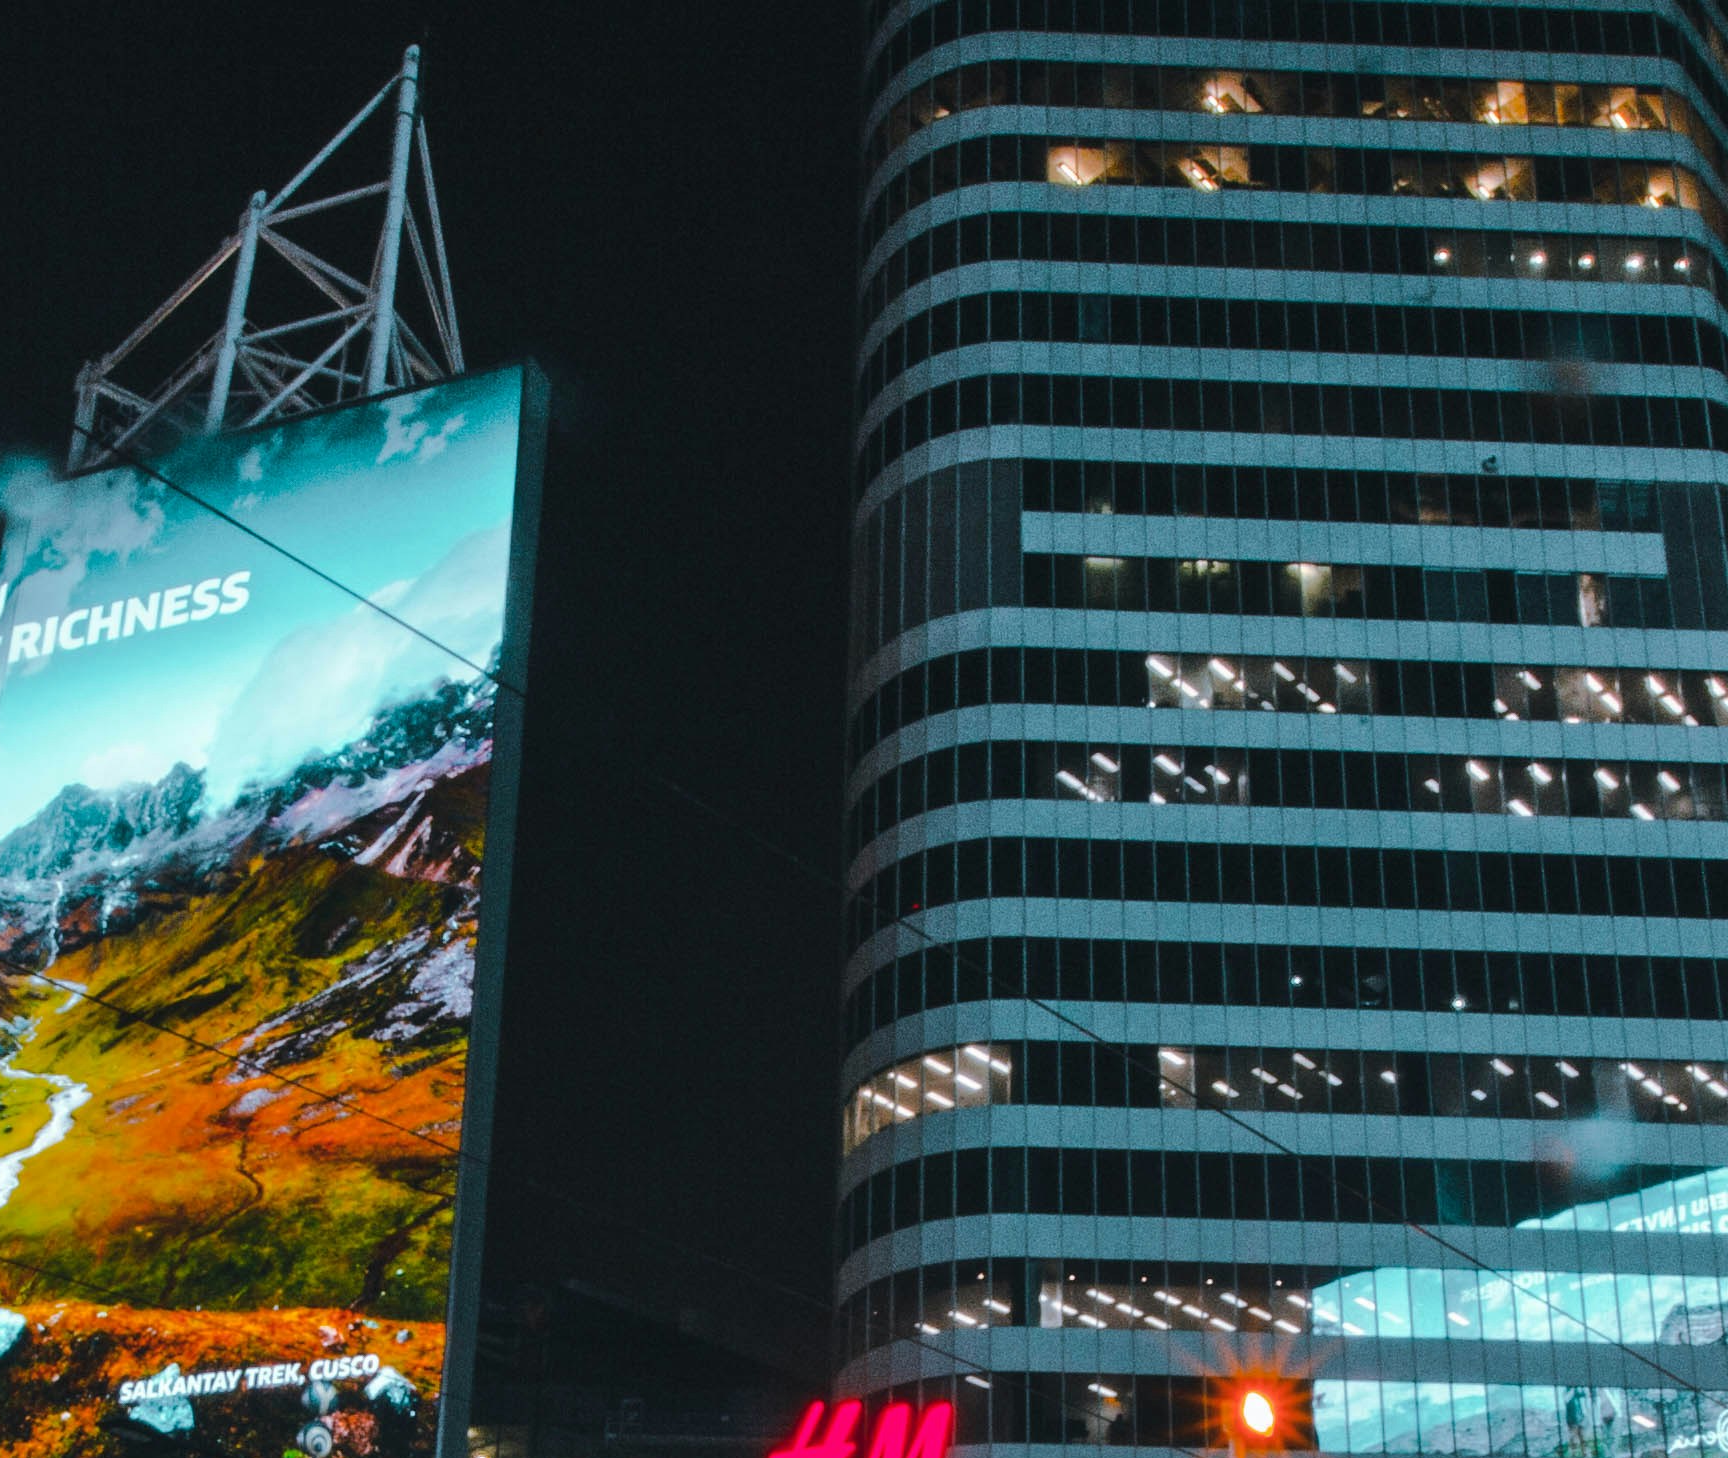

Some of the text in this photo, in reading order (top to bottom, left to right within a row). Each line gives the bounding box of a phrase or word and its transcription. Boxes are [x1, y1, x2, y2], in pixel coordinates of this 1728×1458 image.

[8, 571, 251, 664] RICHNESS
[119, 1353, 380, 1406] SALKANTAY TREK, CUSCO
